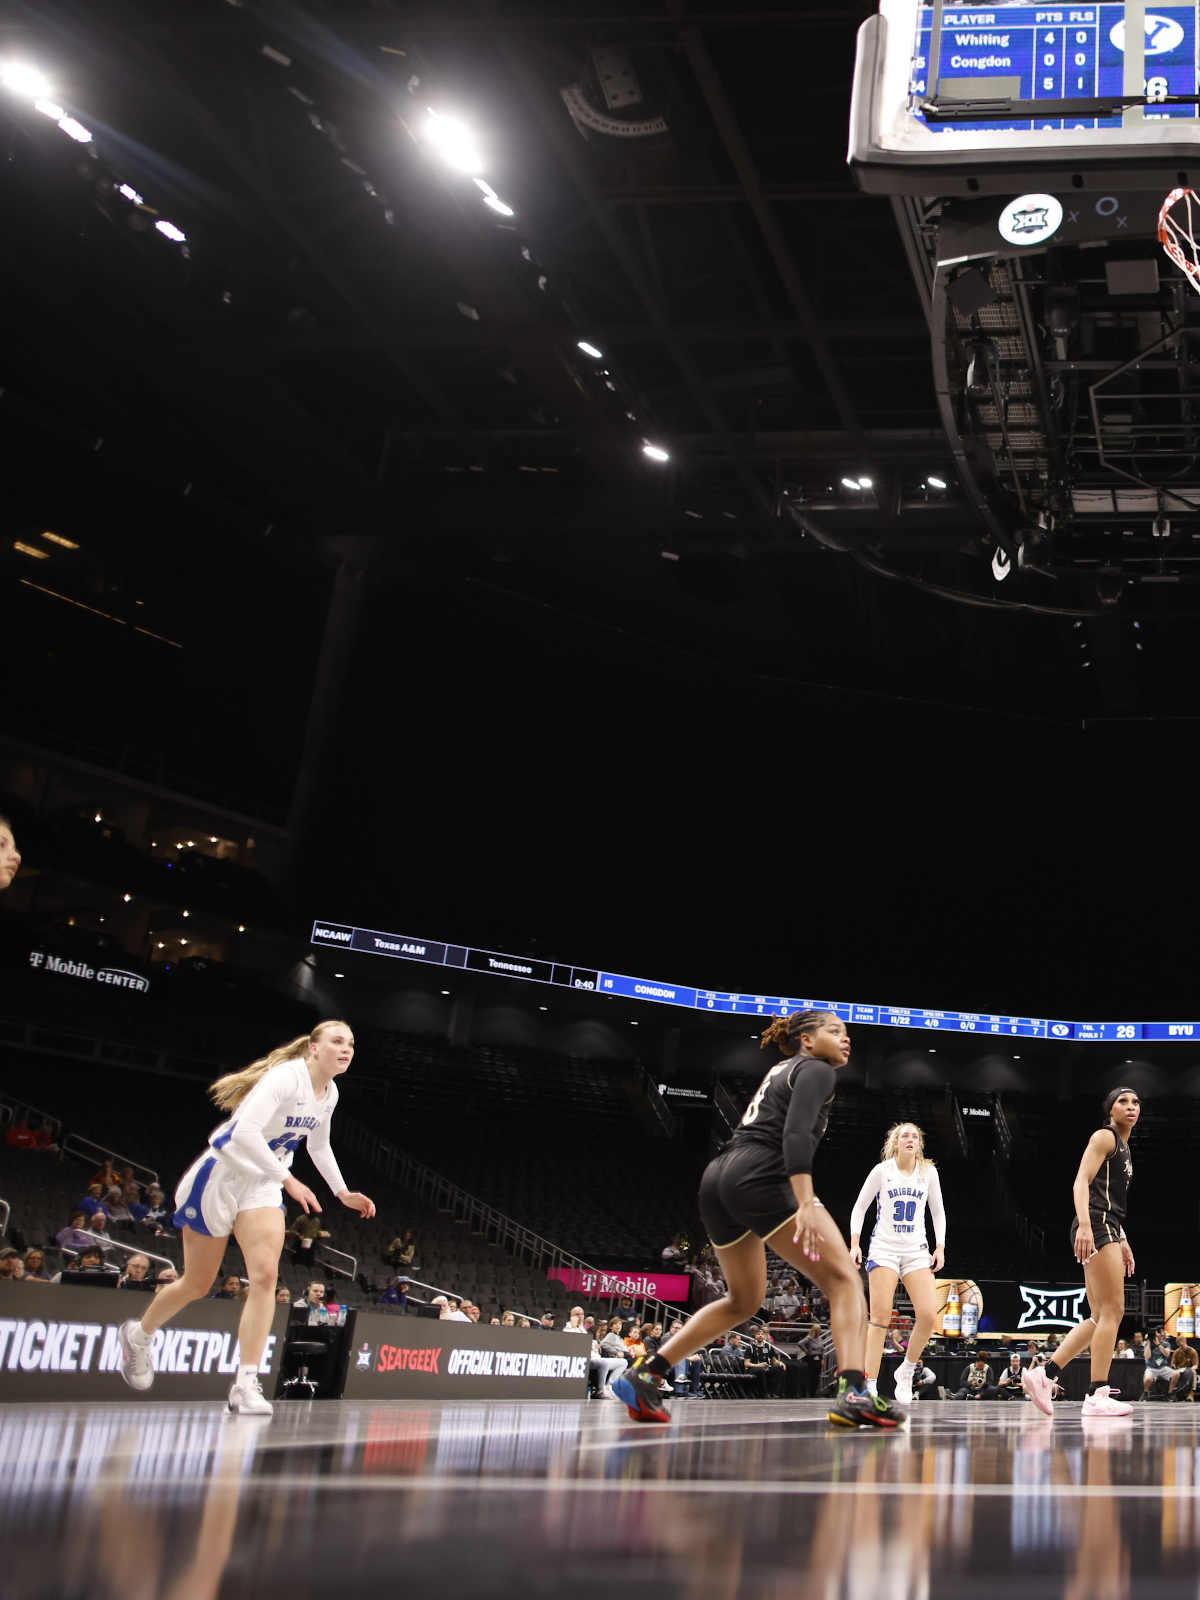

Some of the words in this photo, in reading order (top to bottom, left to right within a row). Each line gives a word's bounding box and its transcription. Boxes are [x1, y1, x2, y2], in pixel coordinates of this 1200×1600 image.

[944, 14, 995, 25] PLAYER
[1036, 12, 1063, 22] PTS
[1070, 12, 1094, 21] FLS
[955, 33, 1010, 47] Whiting
[1044, 32, 1055, 44] 4
[1075, 31, 1087, 44] 0
[951, 55, 1011, 70] Congdon
[1044, 54, 1055, 66] 0
[1075, 53, 1086, 66] 0
[1043, 78, 1053, 90] 5
[315, 928, 351, 942] NCAAW
[374, 938, 400, 951] Texas
[401, 943, 425, 955] A&M
[489, 958, 532, 974] Tennessee
[575, 979, 594, 990] 0:40
[45, 955, 94, 979] Mobile
[97, 971, 145, 991] CENTER
[604, 979, 613, 988] 15
[635, 984, 675, 999] CONGDON
[707, 1000, 714, 1008] 0
[890, 1016, 910, 1025] 11/22
[925, 1019, 939, 1028] 4/9
[960, 1022, 976, 1031] 0/0
[991, 1024, 999, 1032] 12
[1033, 1027, 1039, 1035] 7
[1116, 1026, 1135, 1038] 26
[1168, 1025, 1193, 1035] BYU
[969, 1108, 990, 1116] Mobile
[888, 1188, 924, 1199] BRIGHAM
[893, 1201, 916, 1221] 30
[600, 1275, 656, 1295] Mobile
[99, 1324, 276, 1374] MRKETPLAE
[377, 1344, 442, 1375] SEATGEEK
[448, 1349, 494, 1375] OFFICIAL
[495, 1351, 528, 1376] TICKET
[526, 1354, 587, 1378] MARKETPLACE
